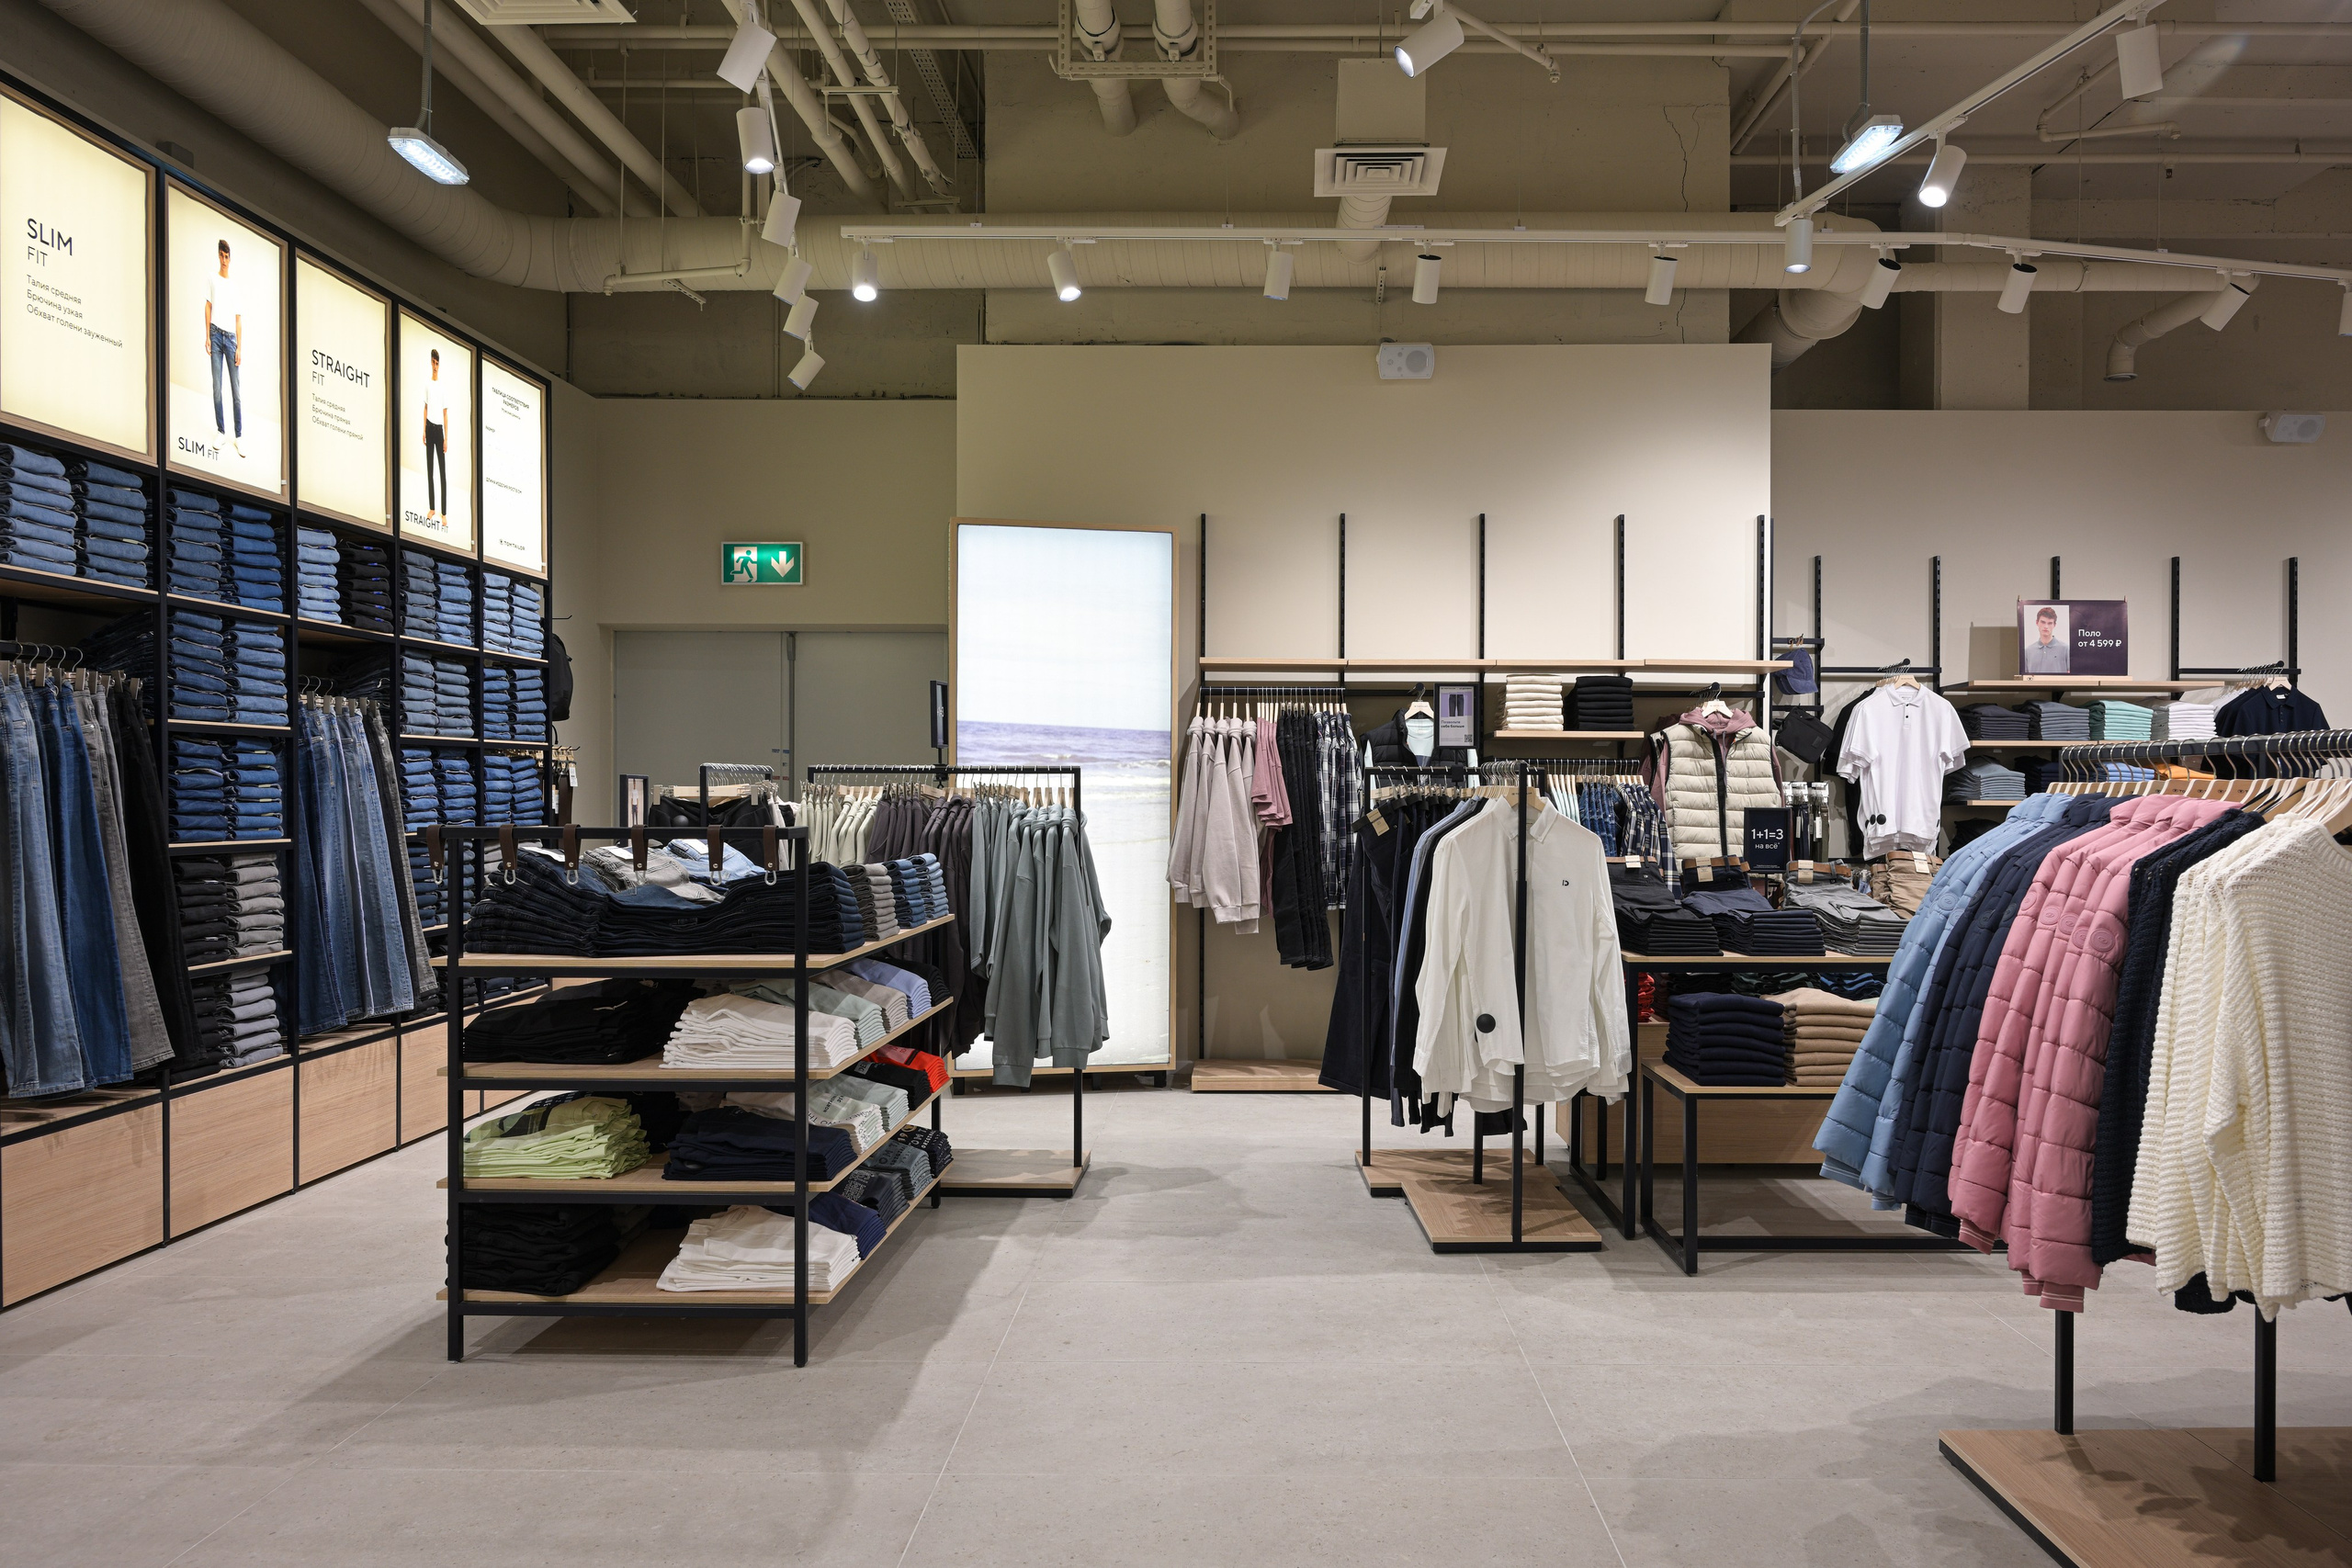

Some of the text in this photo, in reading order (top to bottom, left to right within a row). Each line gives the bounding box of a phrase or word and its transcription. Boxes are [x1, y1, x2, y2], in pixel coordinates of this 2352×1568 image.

[27, 218, 74, 256] SLIM
[27, 245, 49, 267] FIT
[27, 274, 82, 305] Талия средняя
[27, 288, 84, 320] Брючина узкая
[27, 303, 123, 349] Обхват голени зауженный
[311, 349, 370, 389] STRAIGHT
[312, 370, 325, 386] FIT
[177, 436, 220, 461] SLIM FIT
[404, 510, 449, 534] STRAIGHT FIT
[2077, 628, 2101, 637] Поло
[2089, 639, 2096, 648] 4
[2097, 639, 2114, 648] 599
[1751, 828, 1784, 840] 1+1=3
